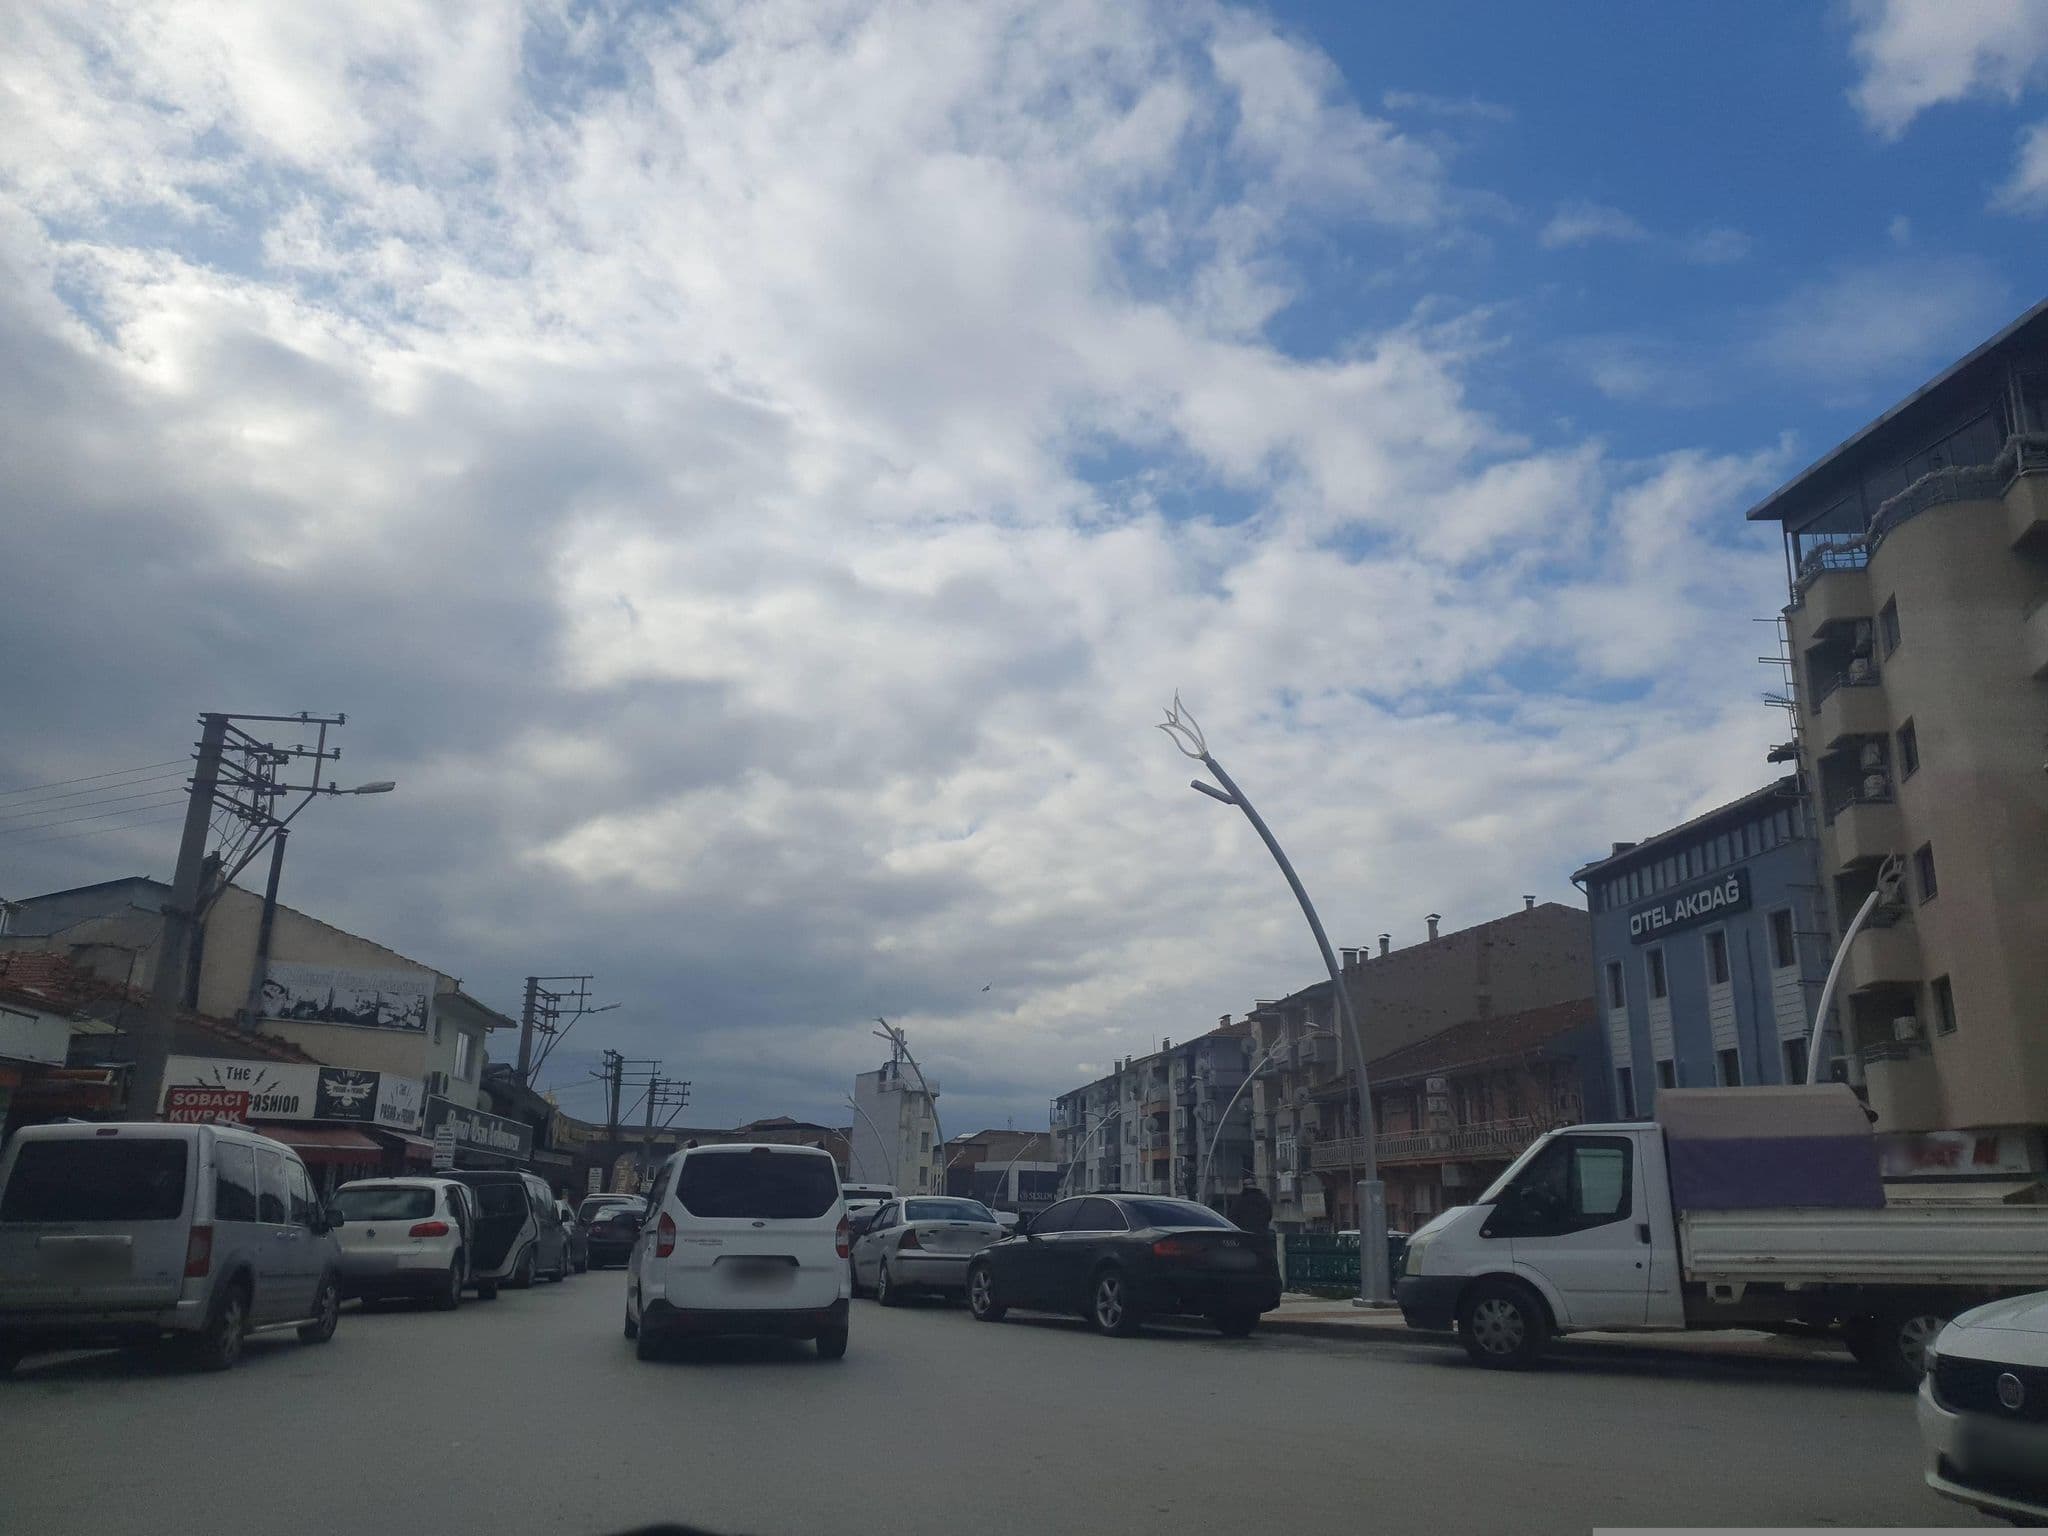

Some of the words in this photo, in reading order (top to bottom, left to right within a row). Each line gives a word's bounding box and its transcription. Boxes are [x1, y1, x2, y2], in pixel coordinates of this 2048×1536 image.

[1630, 905, 1673, 936] OTEL
[1674, 873, 1740, 922] AKDAĞ
[226, 1066, 251, 1081] THE
[172, 1092, 242, 1107] SOBACI
